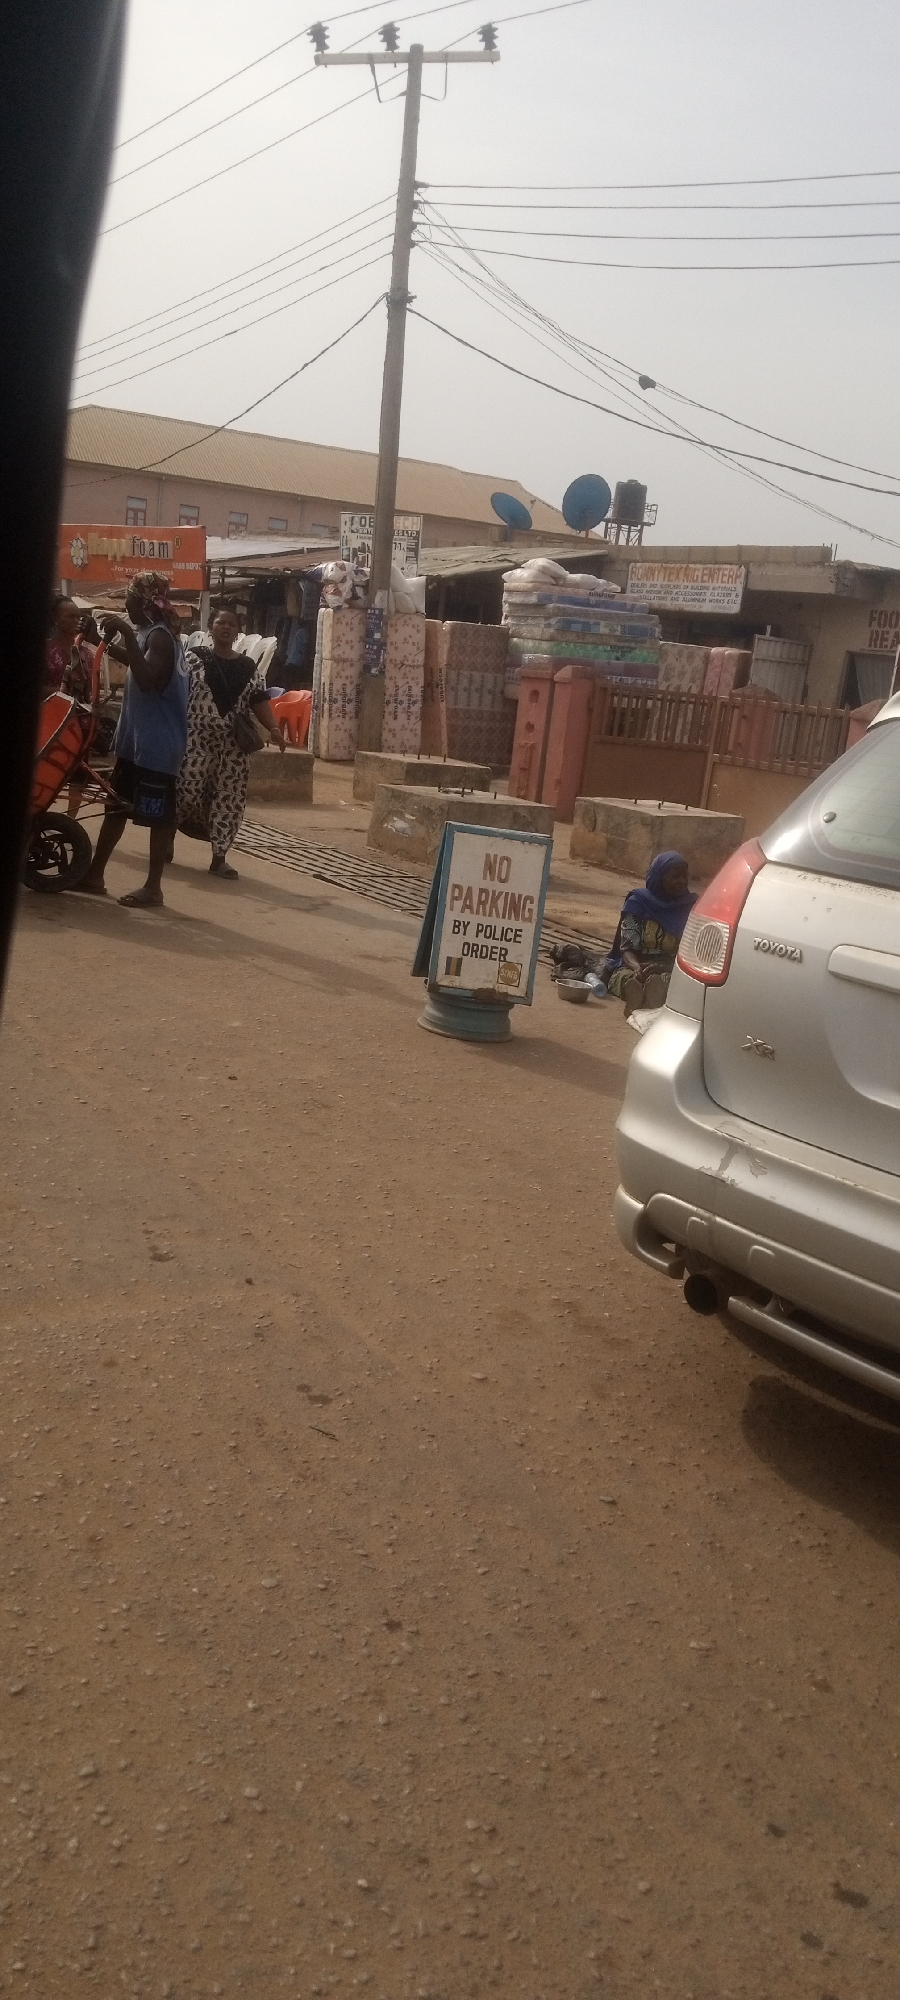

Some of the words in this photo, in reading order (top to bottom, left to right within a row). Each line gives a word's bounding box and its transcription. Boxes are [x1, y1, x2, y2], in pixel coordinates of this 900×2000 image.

[482, 853, 512, 883] NO
[449, 883, 535, 923] PARKING
[452, 919, 471, 936] BY
[475, 923, 523, 944] POLICE
[461, 941, 509, 962] ORDER
[753, 937, 803, 963] TOYOTA
